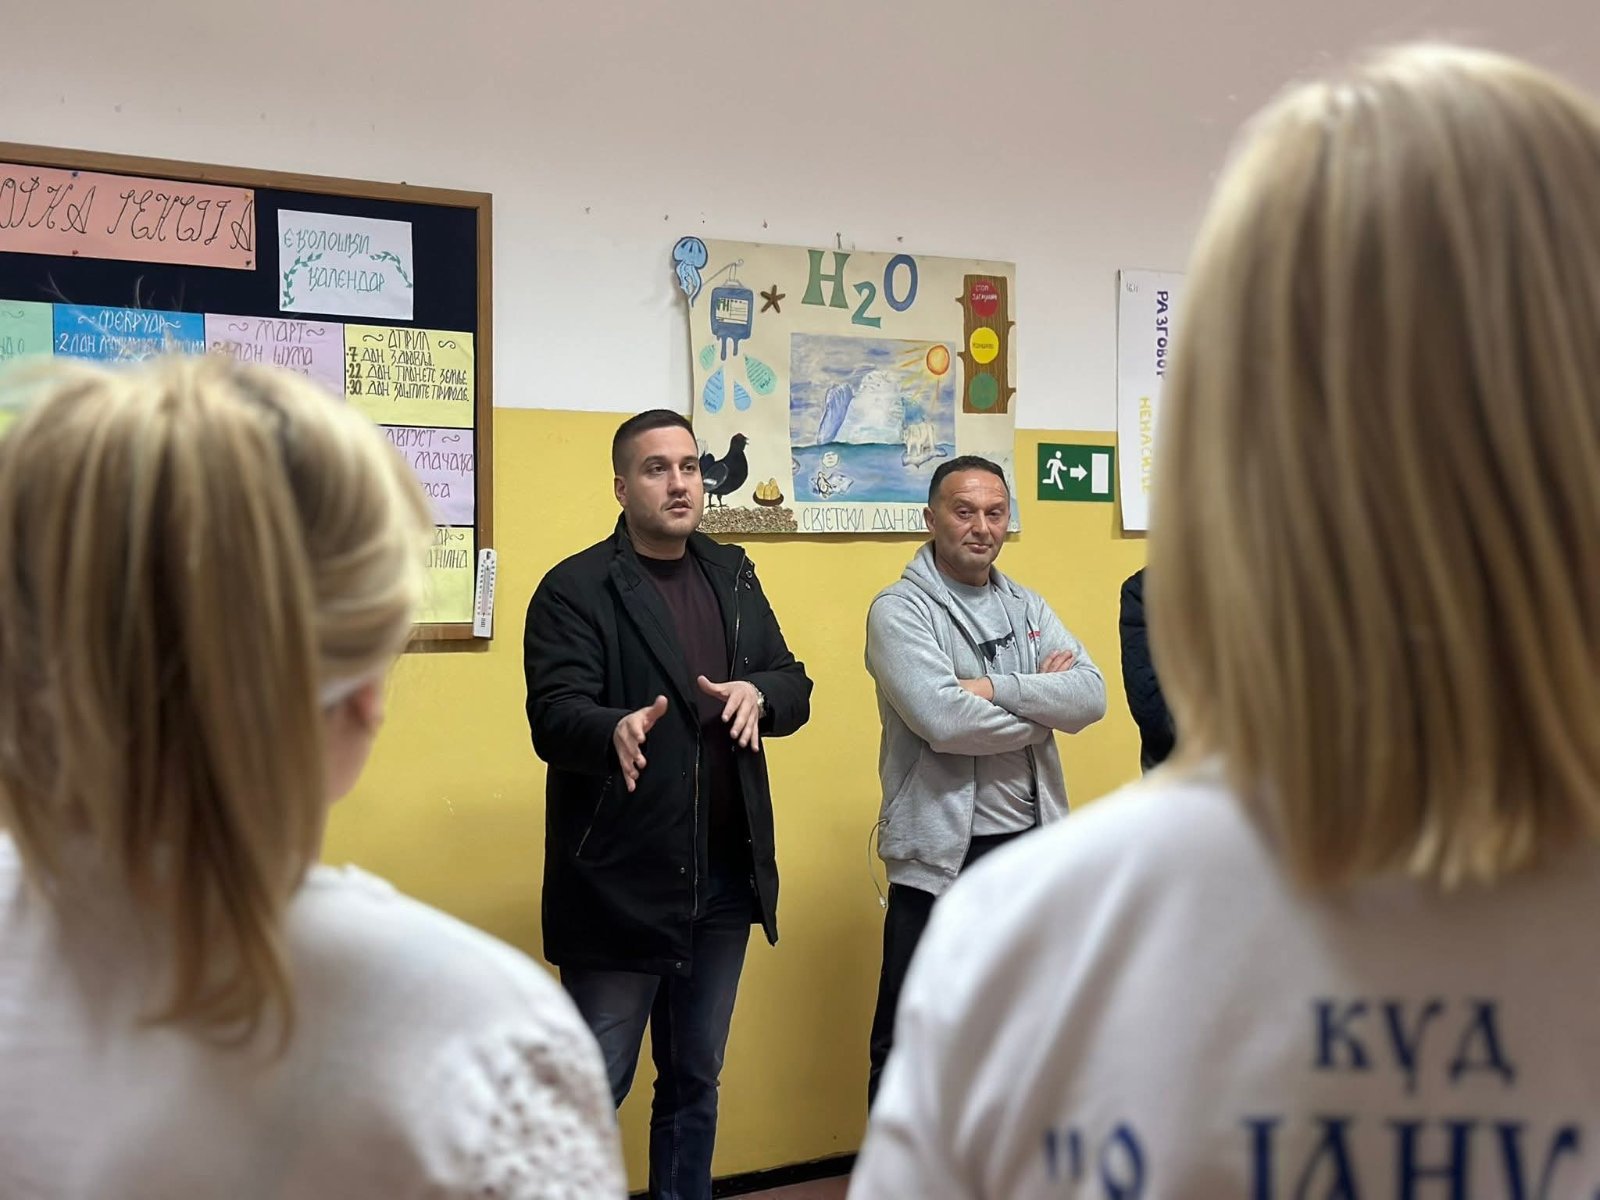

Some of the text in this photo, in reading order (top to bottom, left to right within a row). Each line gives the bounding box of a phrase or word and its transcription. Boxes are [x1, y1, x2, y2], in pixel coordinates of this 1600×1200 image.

[308, 266, 386, 293] КАЛЕНДАР
[255, 319, 308, 345] МАРТ
[387, 328, 431, 351] АПРИЛ
[360, 347, 385, 364] ДАН
[365, 363, 392, 380] ДАН
[365, 379, 391, 397] ДАН
[871, 508, 904, 531] ДАН
[1240, 1113, 1600, 1200] ЈАНУ
